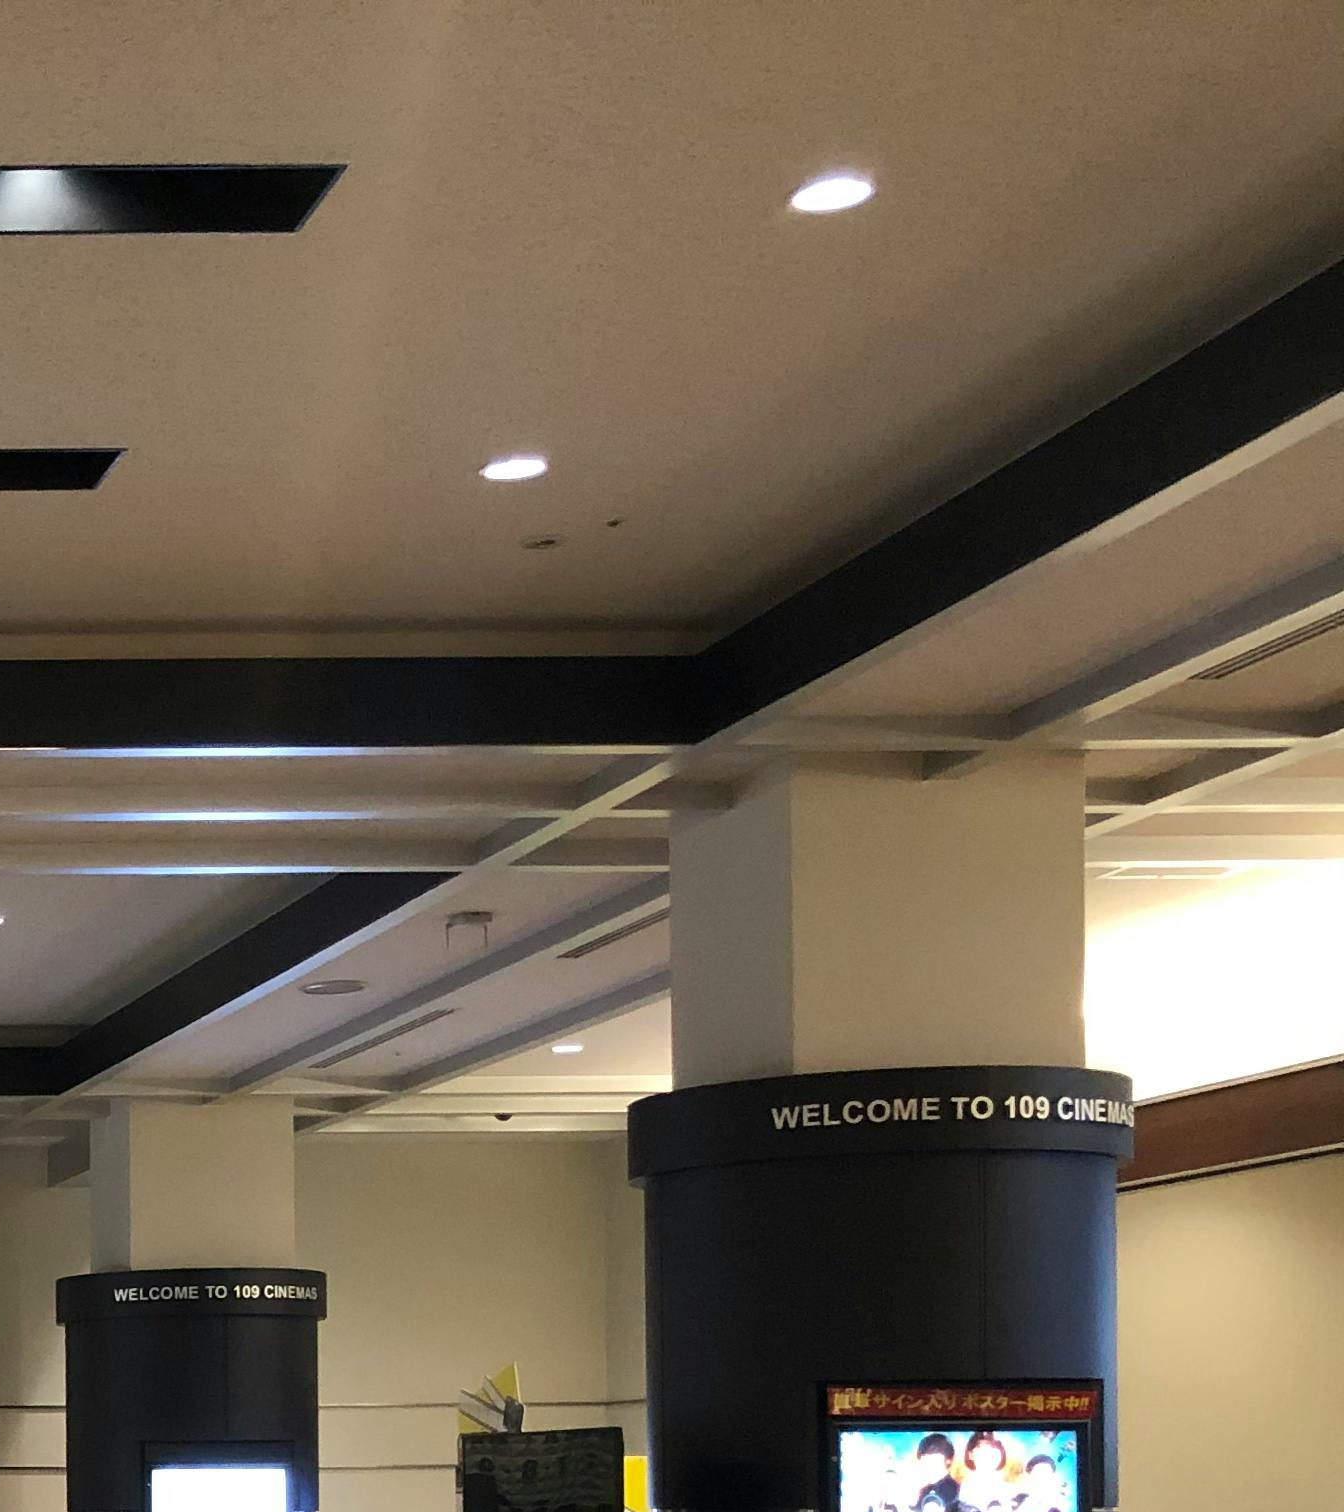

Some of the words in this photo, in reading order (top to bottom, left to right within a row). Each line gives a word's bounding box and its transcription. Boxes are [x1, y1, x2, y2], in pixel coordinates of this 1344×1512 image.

[771, 1098, 941, 1130] WELCOME
[951, 1096, 994, 1120] TO
[1004, 1095, 1049, 1120] 109
[1057, 1098, 1134, 1128] CINEMAS
[114, 1285, 199, 1302] WELCOME
[205, 1285, 228, 1299] TO
[233, 1285, 260, 1298] 109
[264, 1285, 318, 1300] CINEMAS
